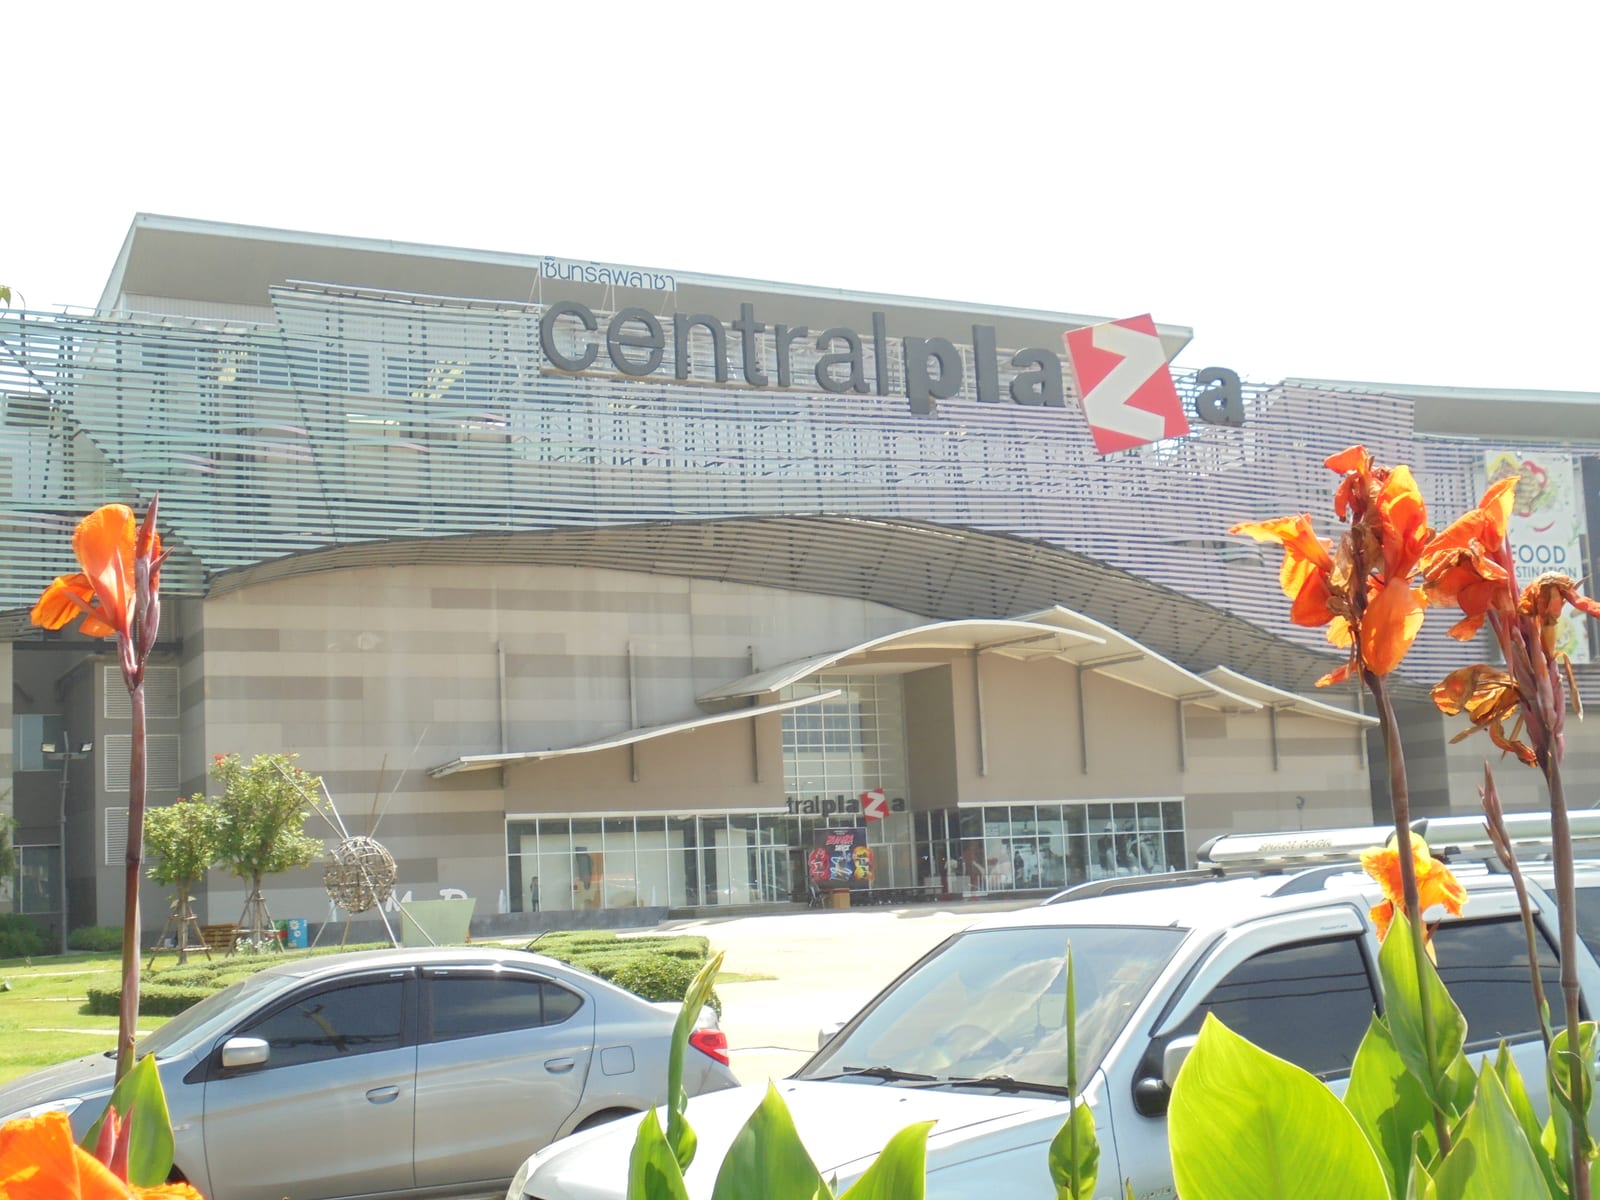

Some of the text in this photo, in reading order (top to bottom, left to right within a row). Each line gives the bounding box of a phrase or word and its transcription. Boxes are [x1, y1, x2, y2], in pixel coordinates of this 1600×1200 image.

[539, 255, 676, 292] เซ็นทรัลพลาซา
